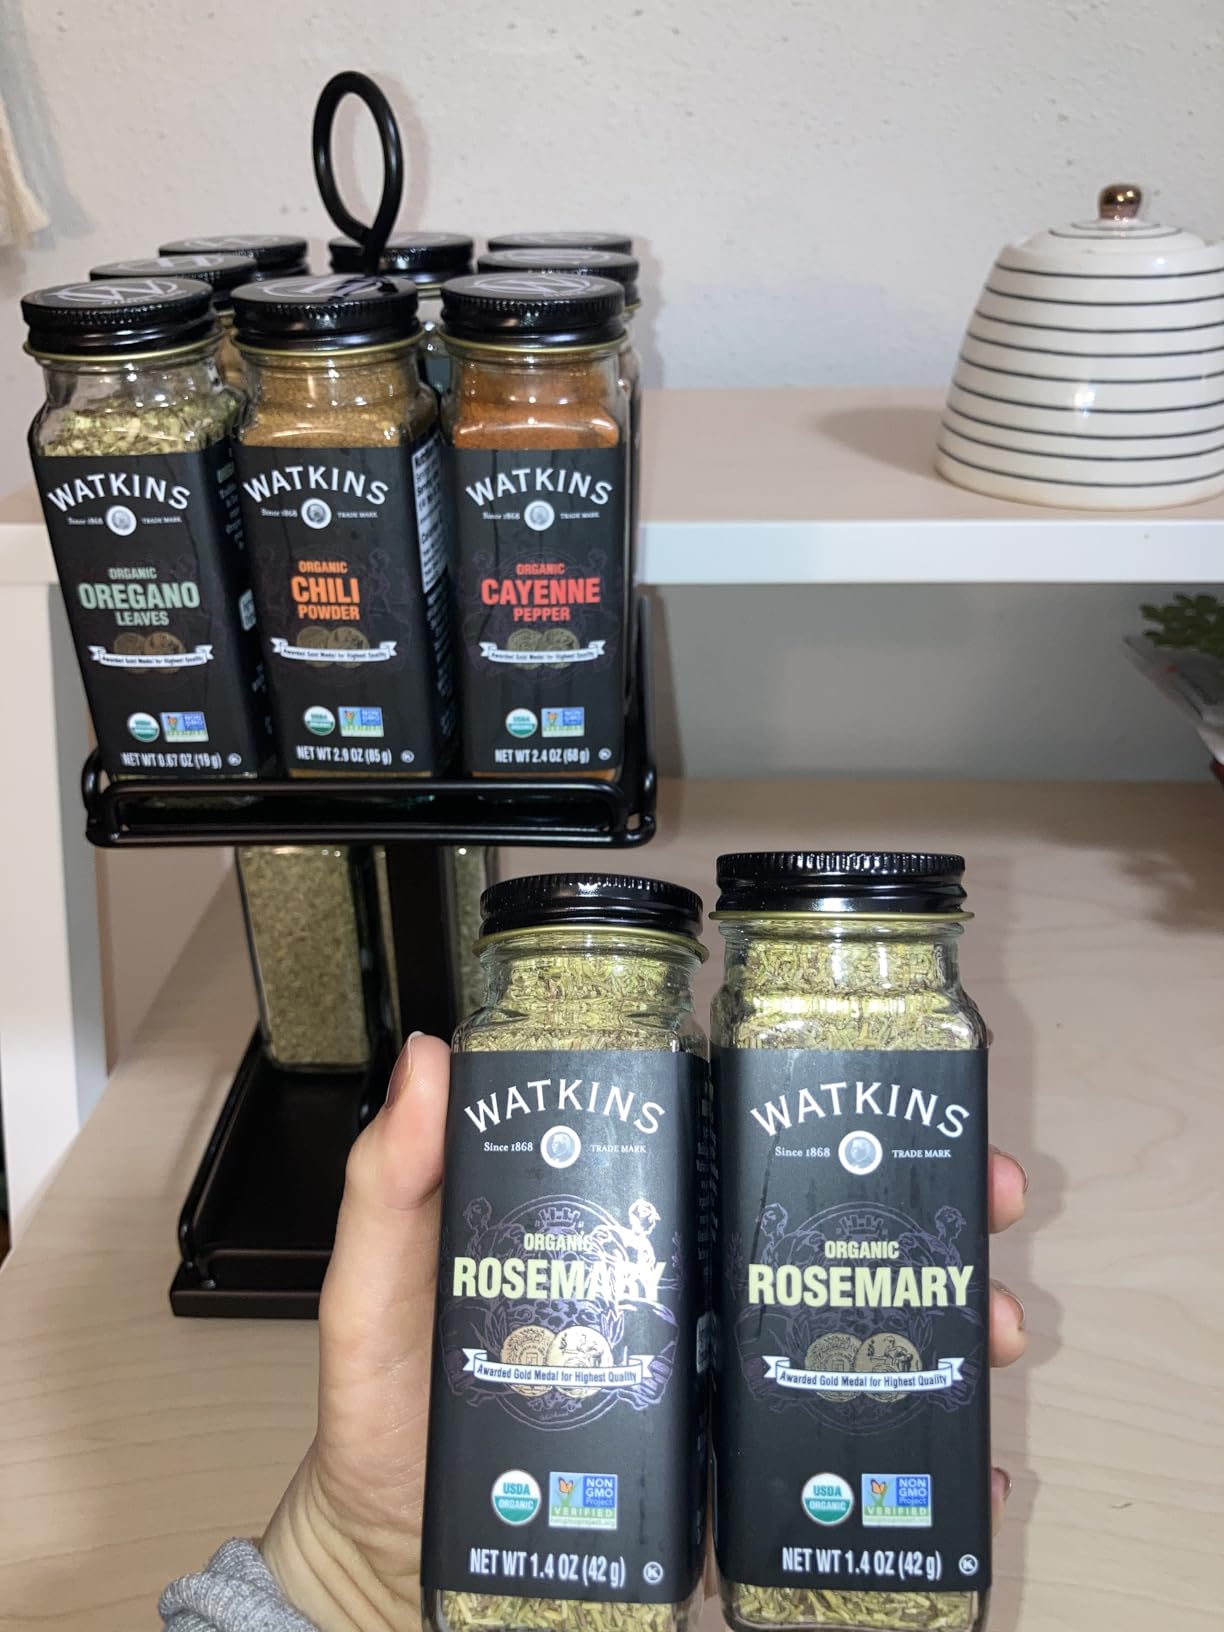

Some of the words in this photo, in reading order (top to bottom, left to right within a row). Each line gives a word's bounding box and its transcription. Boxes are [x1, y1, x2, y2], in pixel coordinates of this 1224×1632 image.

[48, 473, 191, 512] WATKINS
[243, 465, 389, 505] WATKINS
[465, 468, 613, 507] WATKINS
[108, 567, 158, 580] ORGANIC
[298, 560, 348, 574] ORGANIC
[516, 562, 566, 576] ORGANIC
[78, 581, 200, 610] OREGANO
[291, 576, 360, 604] CHILI
[481, 577, 601, 606] CAYENNE
[115, 611, 170, 627] LEAVES
[297, 604, 360, 620] POWDER
[513, 607, 571, 622] PEPPER
[121, 752, 141, 767] NET
[141, 752, 157, 767] WT
[179, 752, 194, 768] OZ
[297, 745, 315, 760] NET
[316, 746, 332, 761] WT
[350, 748, 365, 763] OZ
[495, 749, 514, 763] NET
[515, 749, 531, 763] WT
[549, 748, 562, 763] OZ
[463, 1078, 666, 1134] WATKINS
[750, 1081, 970, 1138] WATKINS
[484, 1142, 509, 1152] Since
[511, 1142, 534, 1152] 1868
[590, 1144, 619, 1153] TRADE
[621, 1144, 647, 1153] MARK
[775, 1146, 803, 1157] Since
[805, 1147, 831, 1158] 1868
[892, 1149, 923, 1158] TRADE
[924, 1149, 952, 1158] MARK
[524, 1232, 593, 1252] ORGANIC
[824, 1240, 900, 1260] ORGANIC
[452, 1256, 666, 1301] ROSEMARY
[748, 1263, 974, 1307] ROSEMARY
[477, 1363, 511, 1379] Awarded
[513, 1368, 532, 1380] Gold
[533, 1369, 558, 1381] Medal
[560, 1371, 573, 1382] for
[574, 1371, 607, 1384] Highest
[607, 1370, 637, 1383] Quality
[780, 1372, 817, 1385] Awarded
[819, 1374, 839, 1386] Gold
[841, 1375, 867, 1387] Medal
[869, 1375, 882, 1387] for
[884, 1375, 916, 1389] Highest
[918, 1374, 947, 1387] Quality
[503, 1482, 530, 1495] USDA
[586, 1478, 613, 1488] NON
[899, 1478, 926, 1488] NON
[585, 1487, 614, 1498] GMO
[813, 1485, 842, 1497] USDA
[899, 1487, 928, 1498] GMO
[499, 1499, 534, 1511] ORGANIC
[585, 1497, 614, 1507] Project
[809, 1500, 846, 1512] ORGANIC
[899, 1497, 927, 1506] Project
[553, 1506, 614, 1518] VERIFIED
[866, 1506, 928, 1516] VERIFIED
[470, 1548, 499, 1575] NET
[502, 1550, 527, 1577] WT
[530, 1552, 554, 1579] 1.4
[558, 1553, 579, 1581] OZ
[582, 1554, 607, 1586] (42
[610, 1556, 626, 1589] g)
[782, 1547, 812, 1572] NET
[816, 1548, 842, 1574] WT
[845, 1550, 870, 1575] 1.4
[873, 1550, 895, 1576] OZ
[898, 1550, 923, 1580] (42
[925, 1551, 943, 1581] g)
